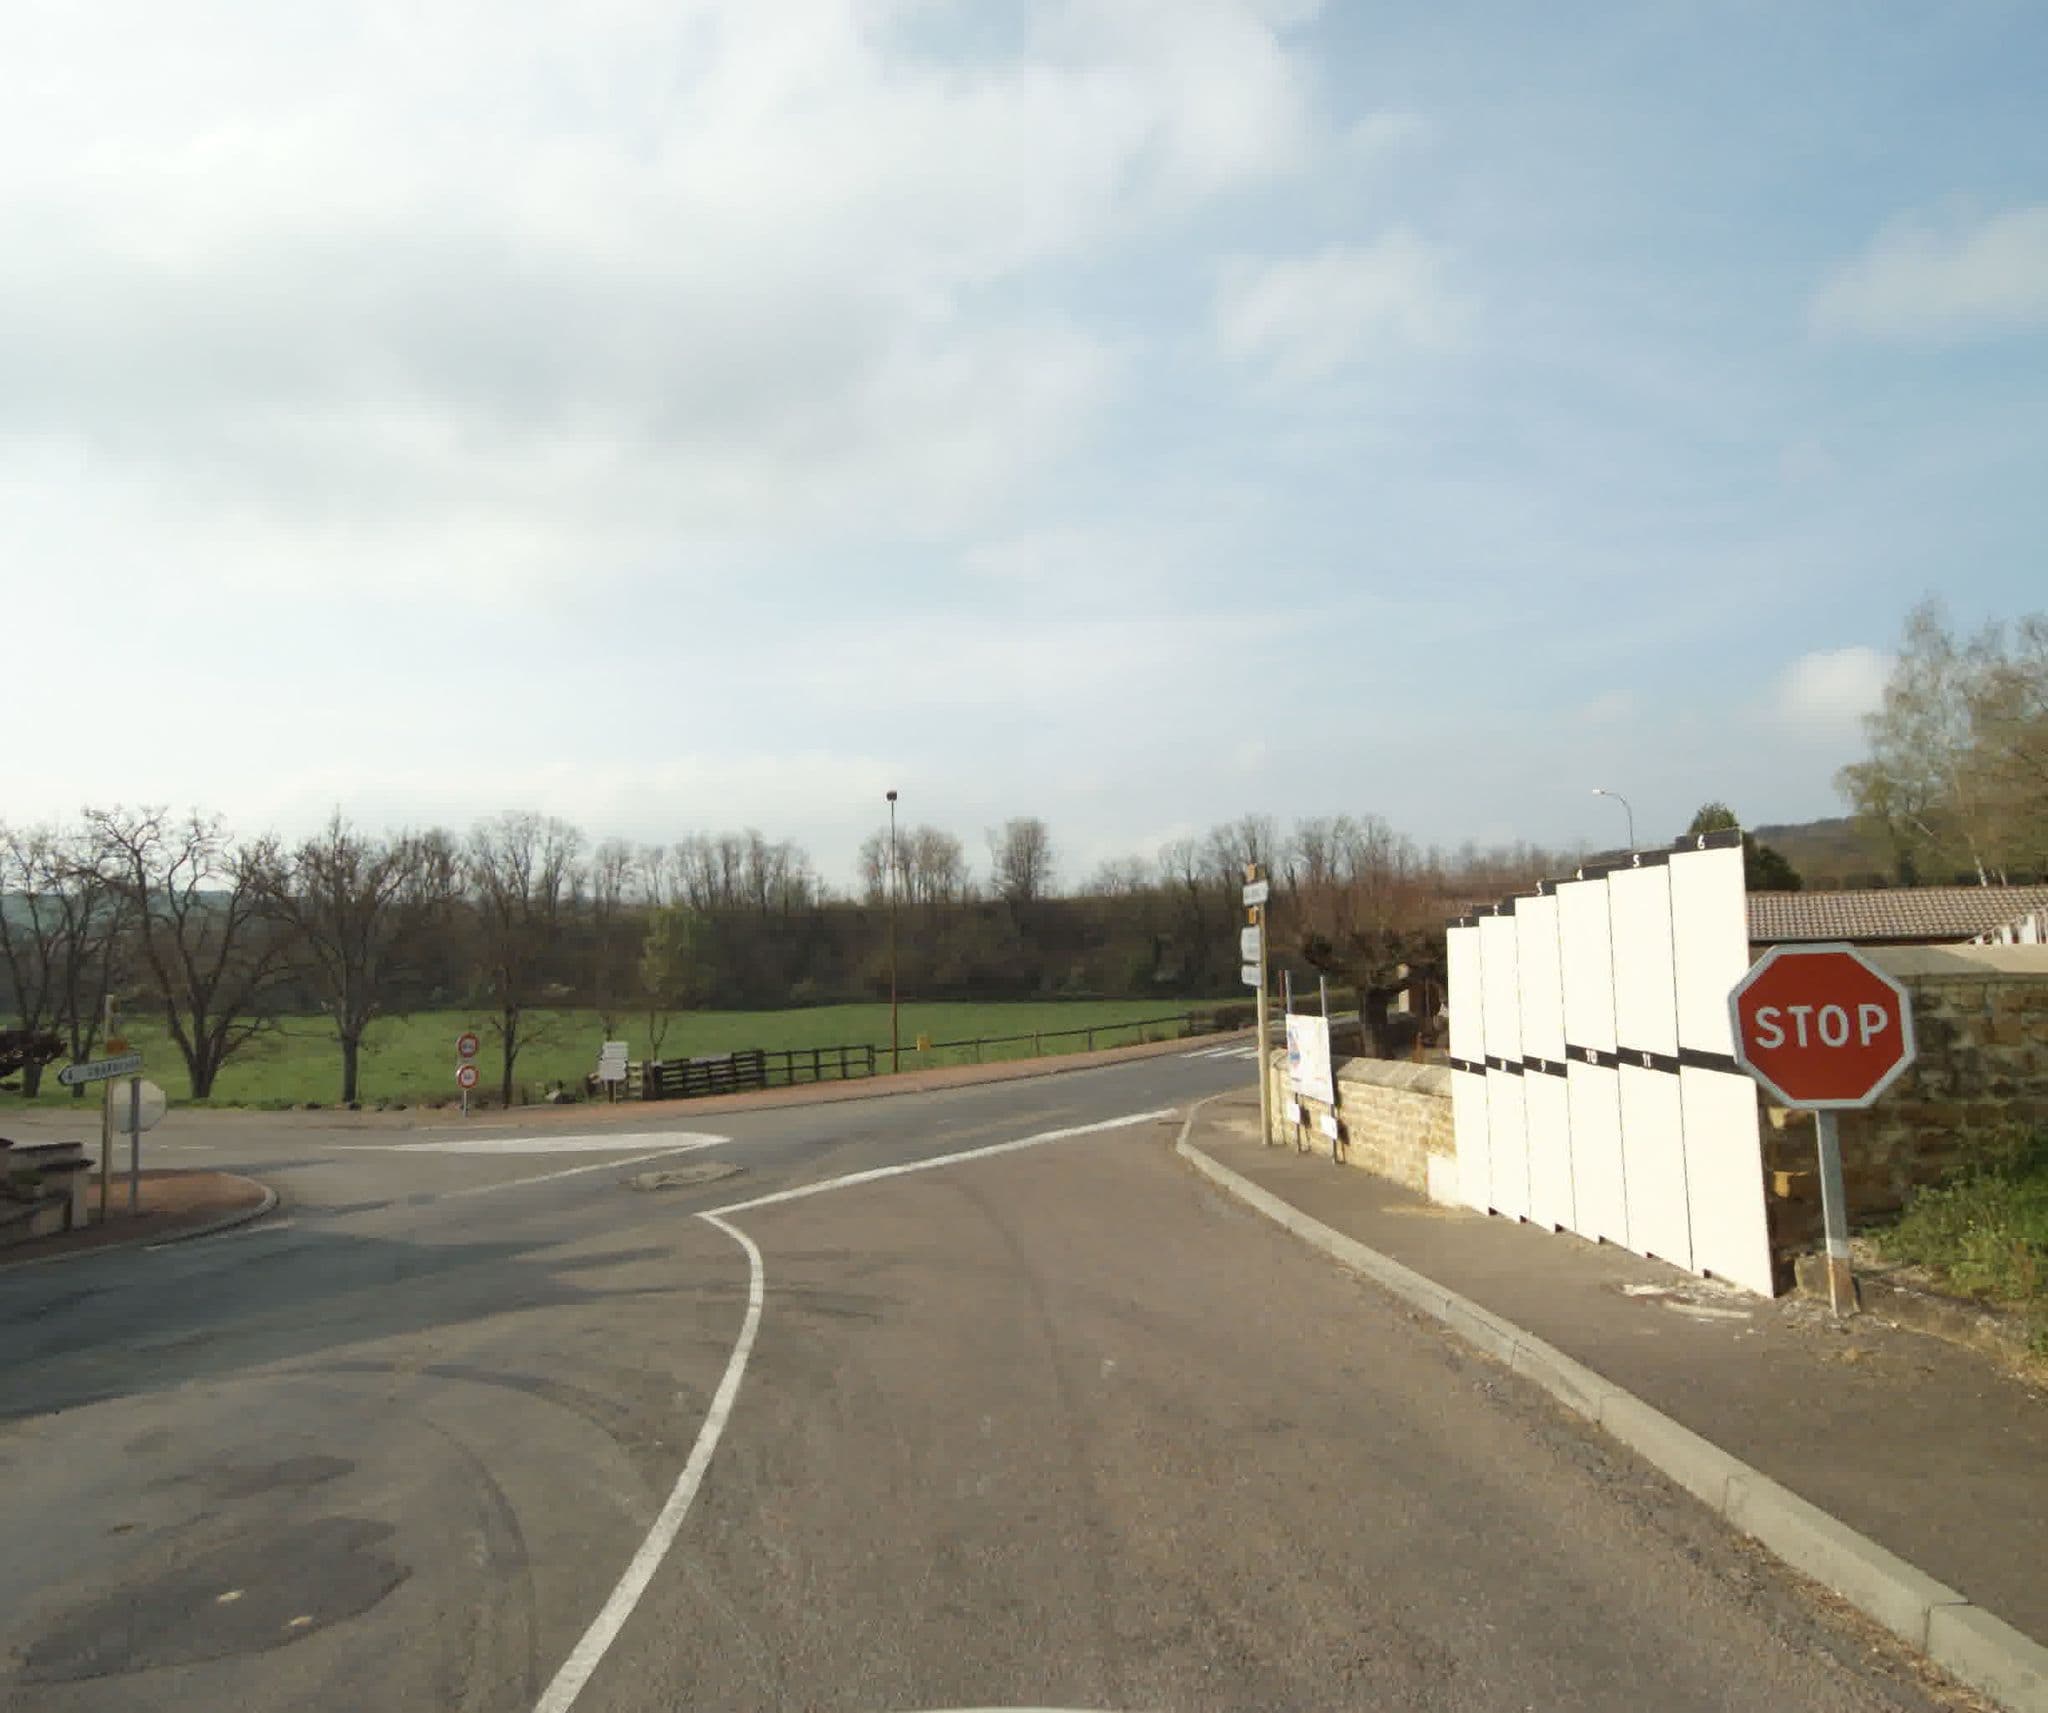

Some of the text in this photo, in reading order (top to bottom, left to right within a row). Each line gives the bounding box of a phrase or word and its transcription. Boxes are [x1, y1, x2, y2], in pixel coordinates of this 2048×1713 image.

[1753, 1003, 1889, 1049] STOP
[1585, 1048, 1598, 1065] 10
[1642, 1052, 1652, 1068] 11
